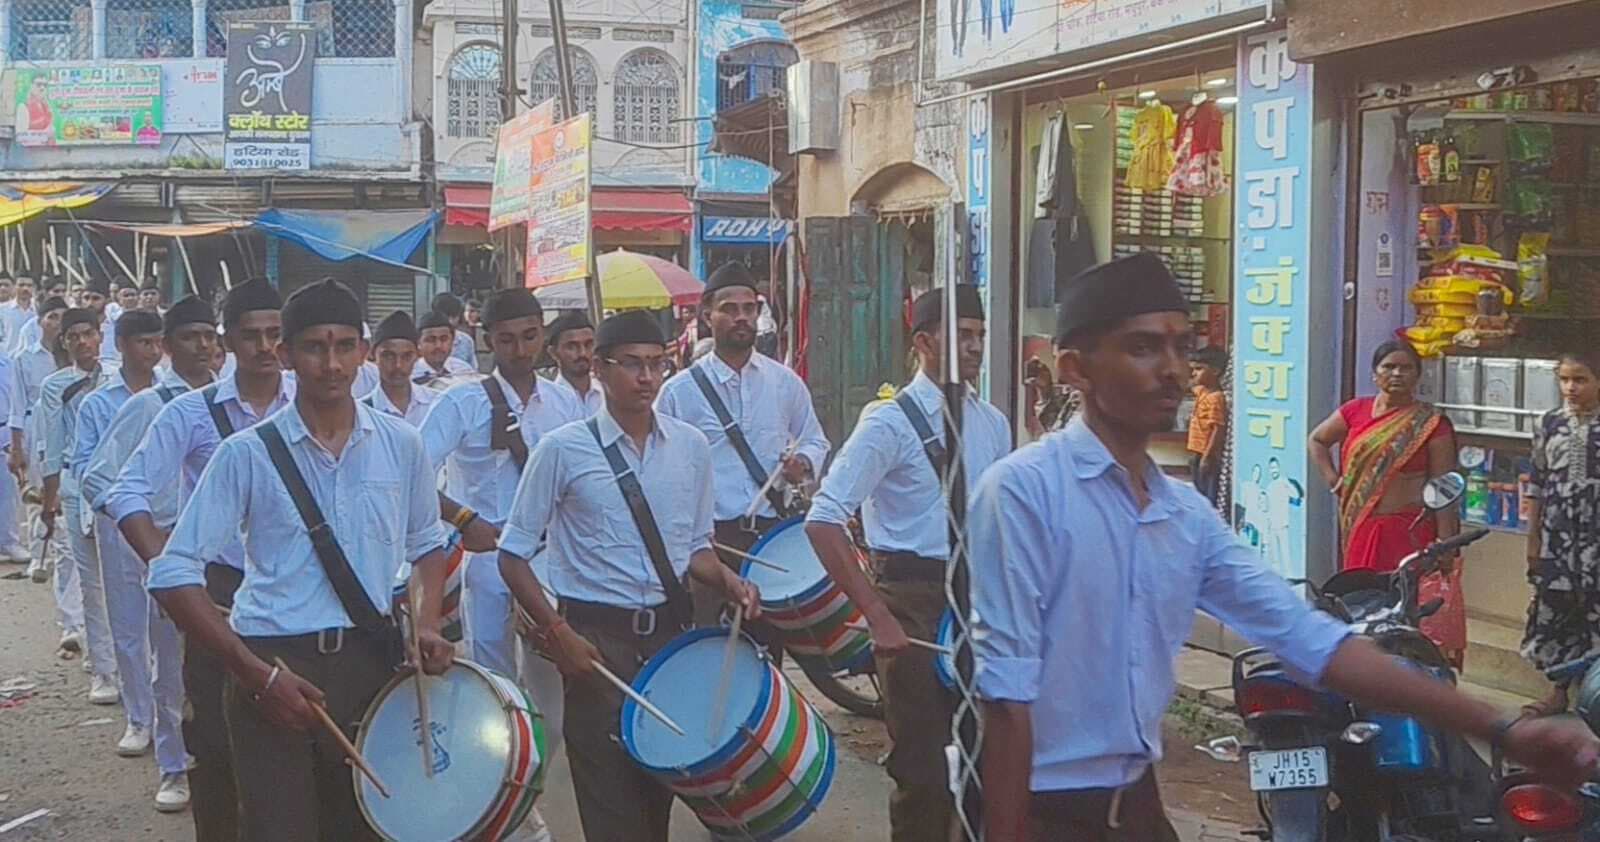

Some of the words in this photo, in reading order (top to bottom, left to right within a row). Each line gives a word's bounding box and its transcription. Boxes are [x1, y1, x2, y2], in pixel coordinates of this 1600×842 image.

[228, 110, 272, 130] क्लॉथ
[275, 110, 310, 129] स्टोर
[1273, 751, 1311, 769] JH15
[1268, 768, 1317, 787] W7355
